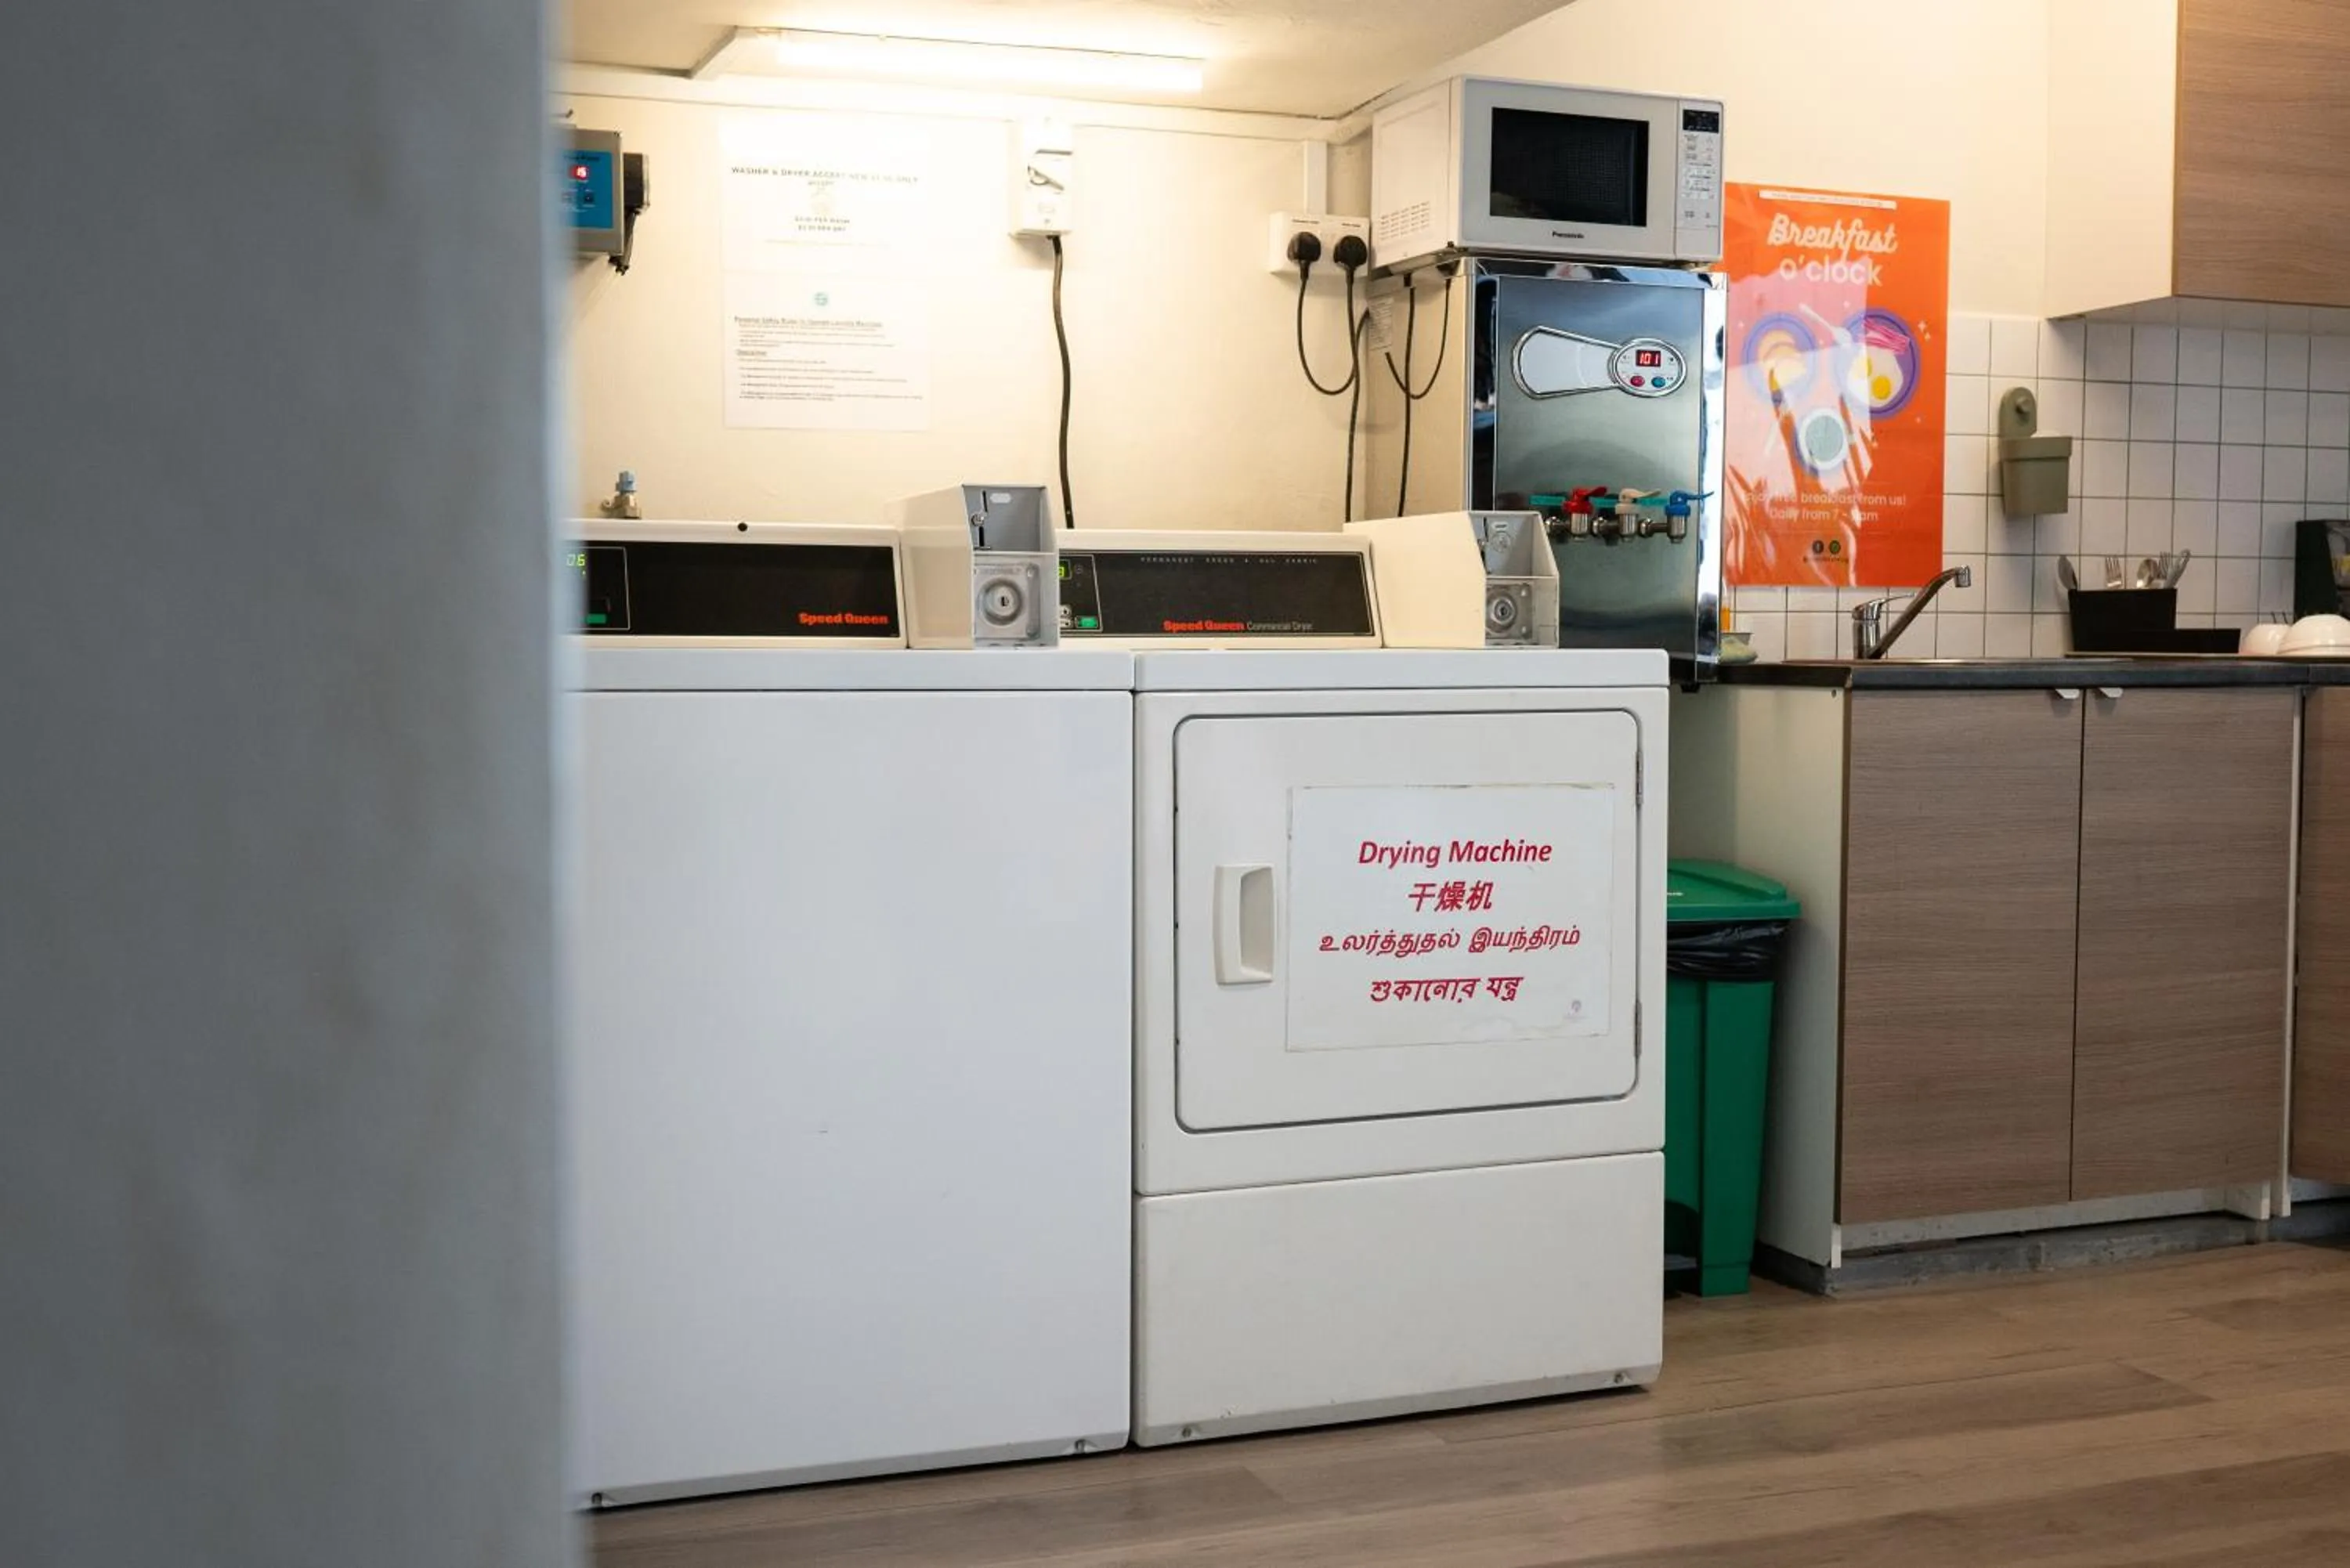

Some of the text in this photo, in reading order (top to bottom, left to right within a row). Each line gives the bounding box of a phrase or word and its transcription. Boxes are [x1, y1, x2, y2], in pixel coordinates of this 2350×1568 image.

[1767, 212, 1898, 262] Breakfast
[1780, 254, 1883, 287] o'clock
[1802, 507, 1830, 520] from
[1889, 493, 1907, 505] us!
[799, 612, 889, 626] Speed Queen
[1163, 620, 1204, 632] Speed
[1204, 620, 1245, 630] Queen
[1358, 839, 1553, 869] Drying Machine
[1408, 880, 1493, 912] 干燥机
[1319, 924, 1580, 957] உலர்த்துதல் இயந்திரம்
